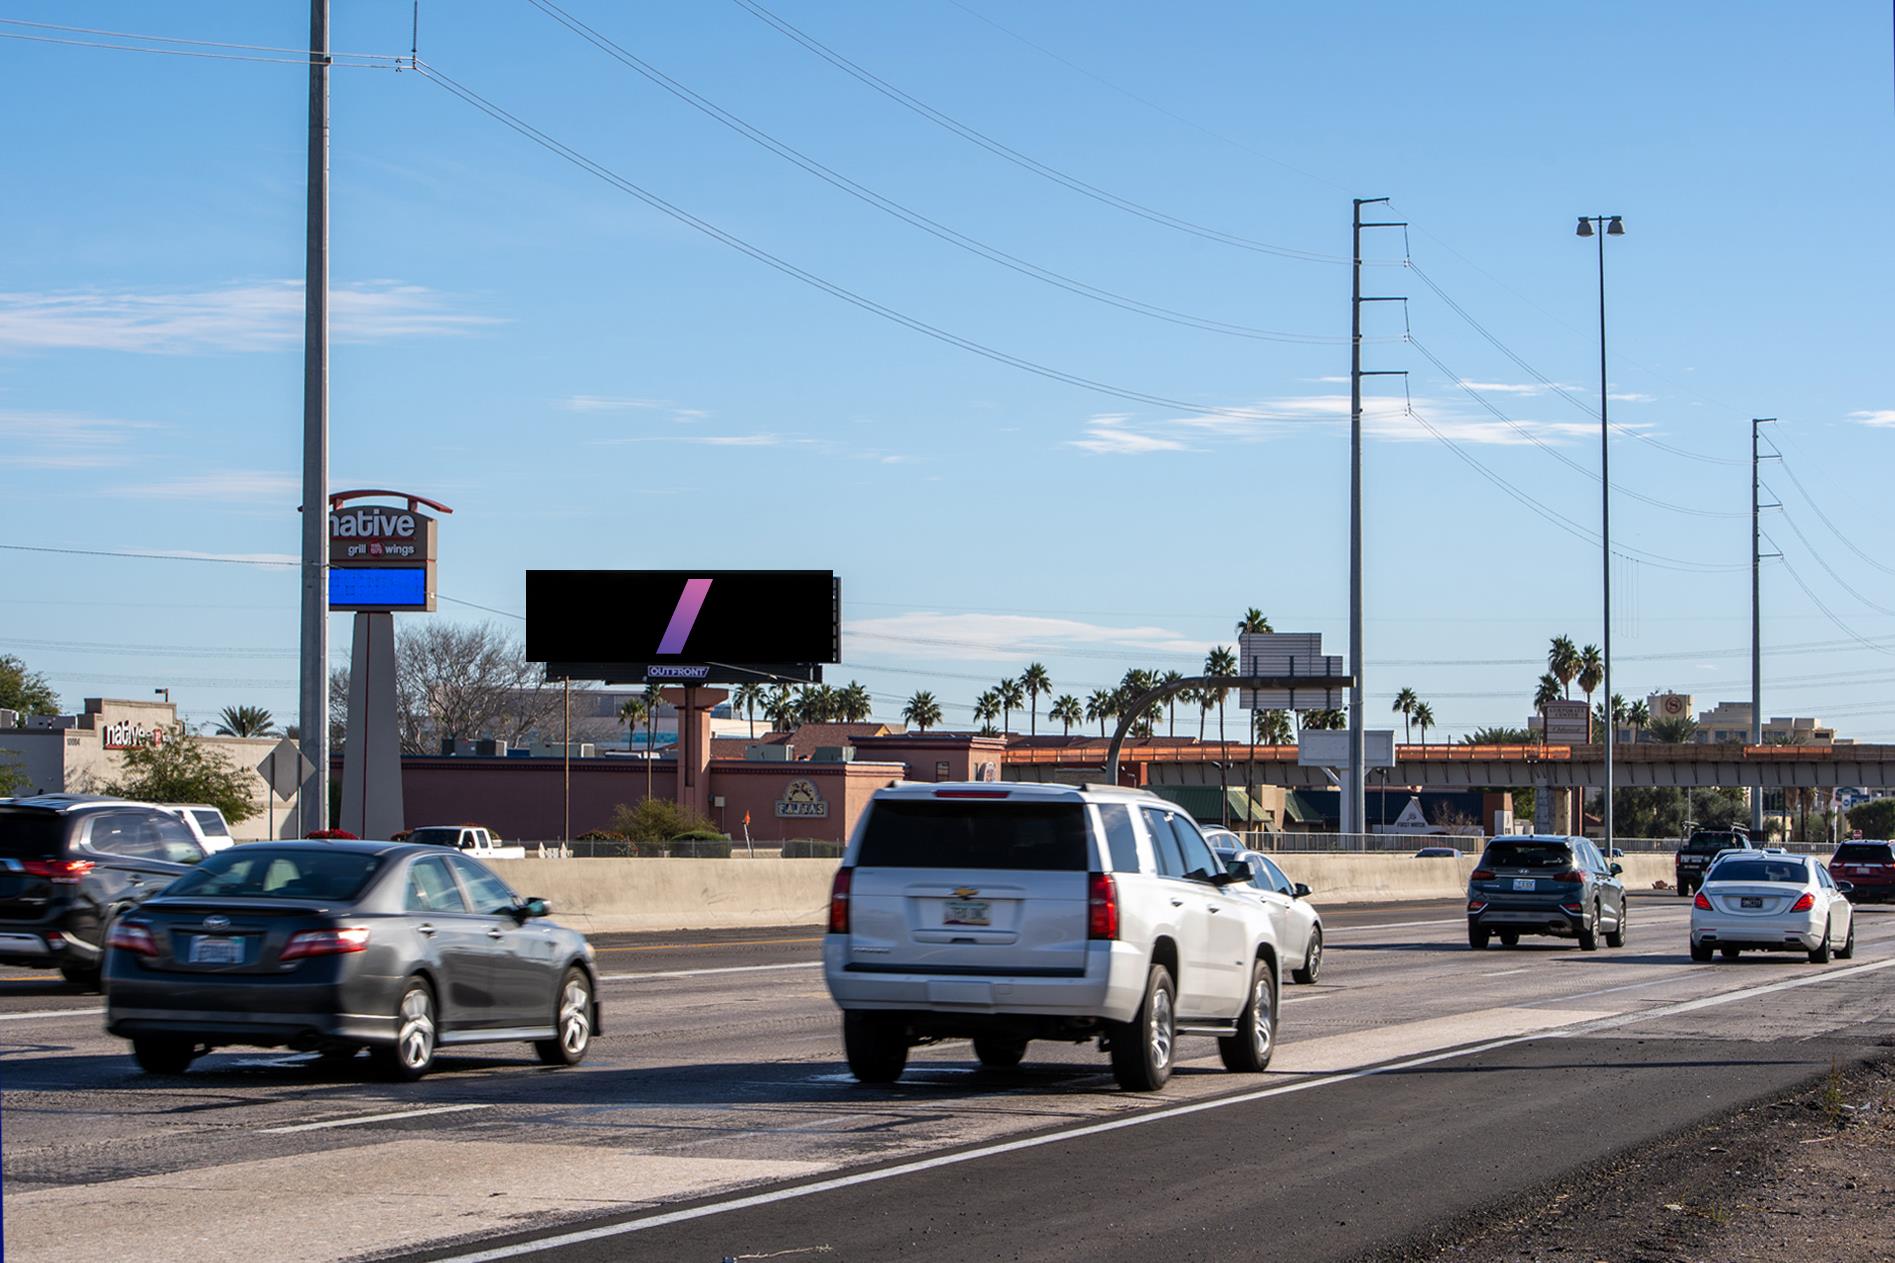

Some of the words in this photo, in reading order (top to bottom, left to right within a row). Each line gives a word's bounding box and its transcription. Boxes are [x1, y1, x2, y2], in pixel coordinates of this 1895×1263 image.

[348, 543, 367, 557] grill
[384, 544, 415, 557] wings
[650, 666, 706, 677] OUTFRONT
